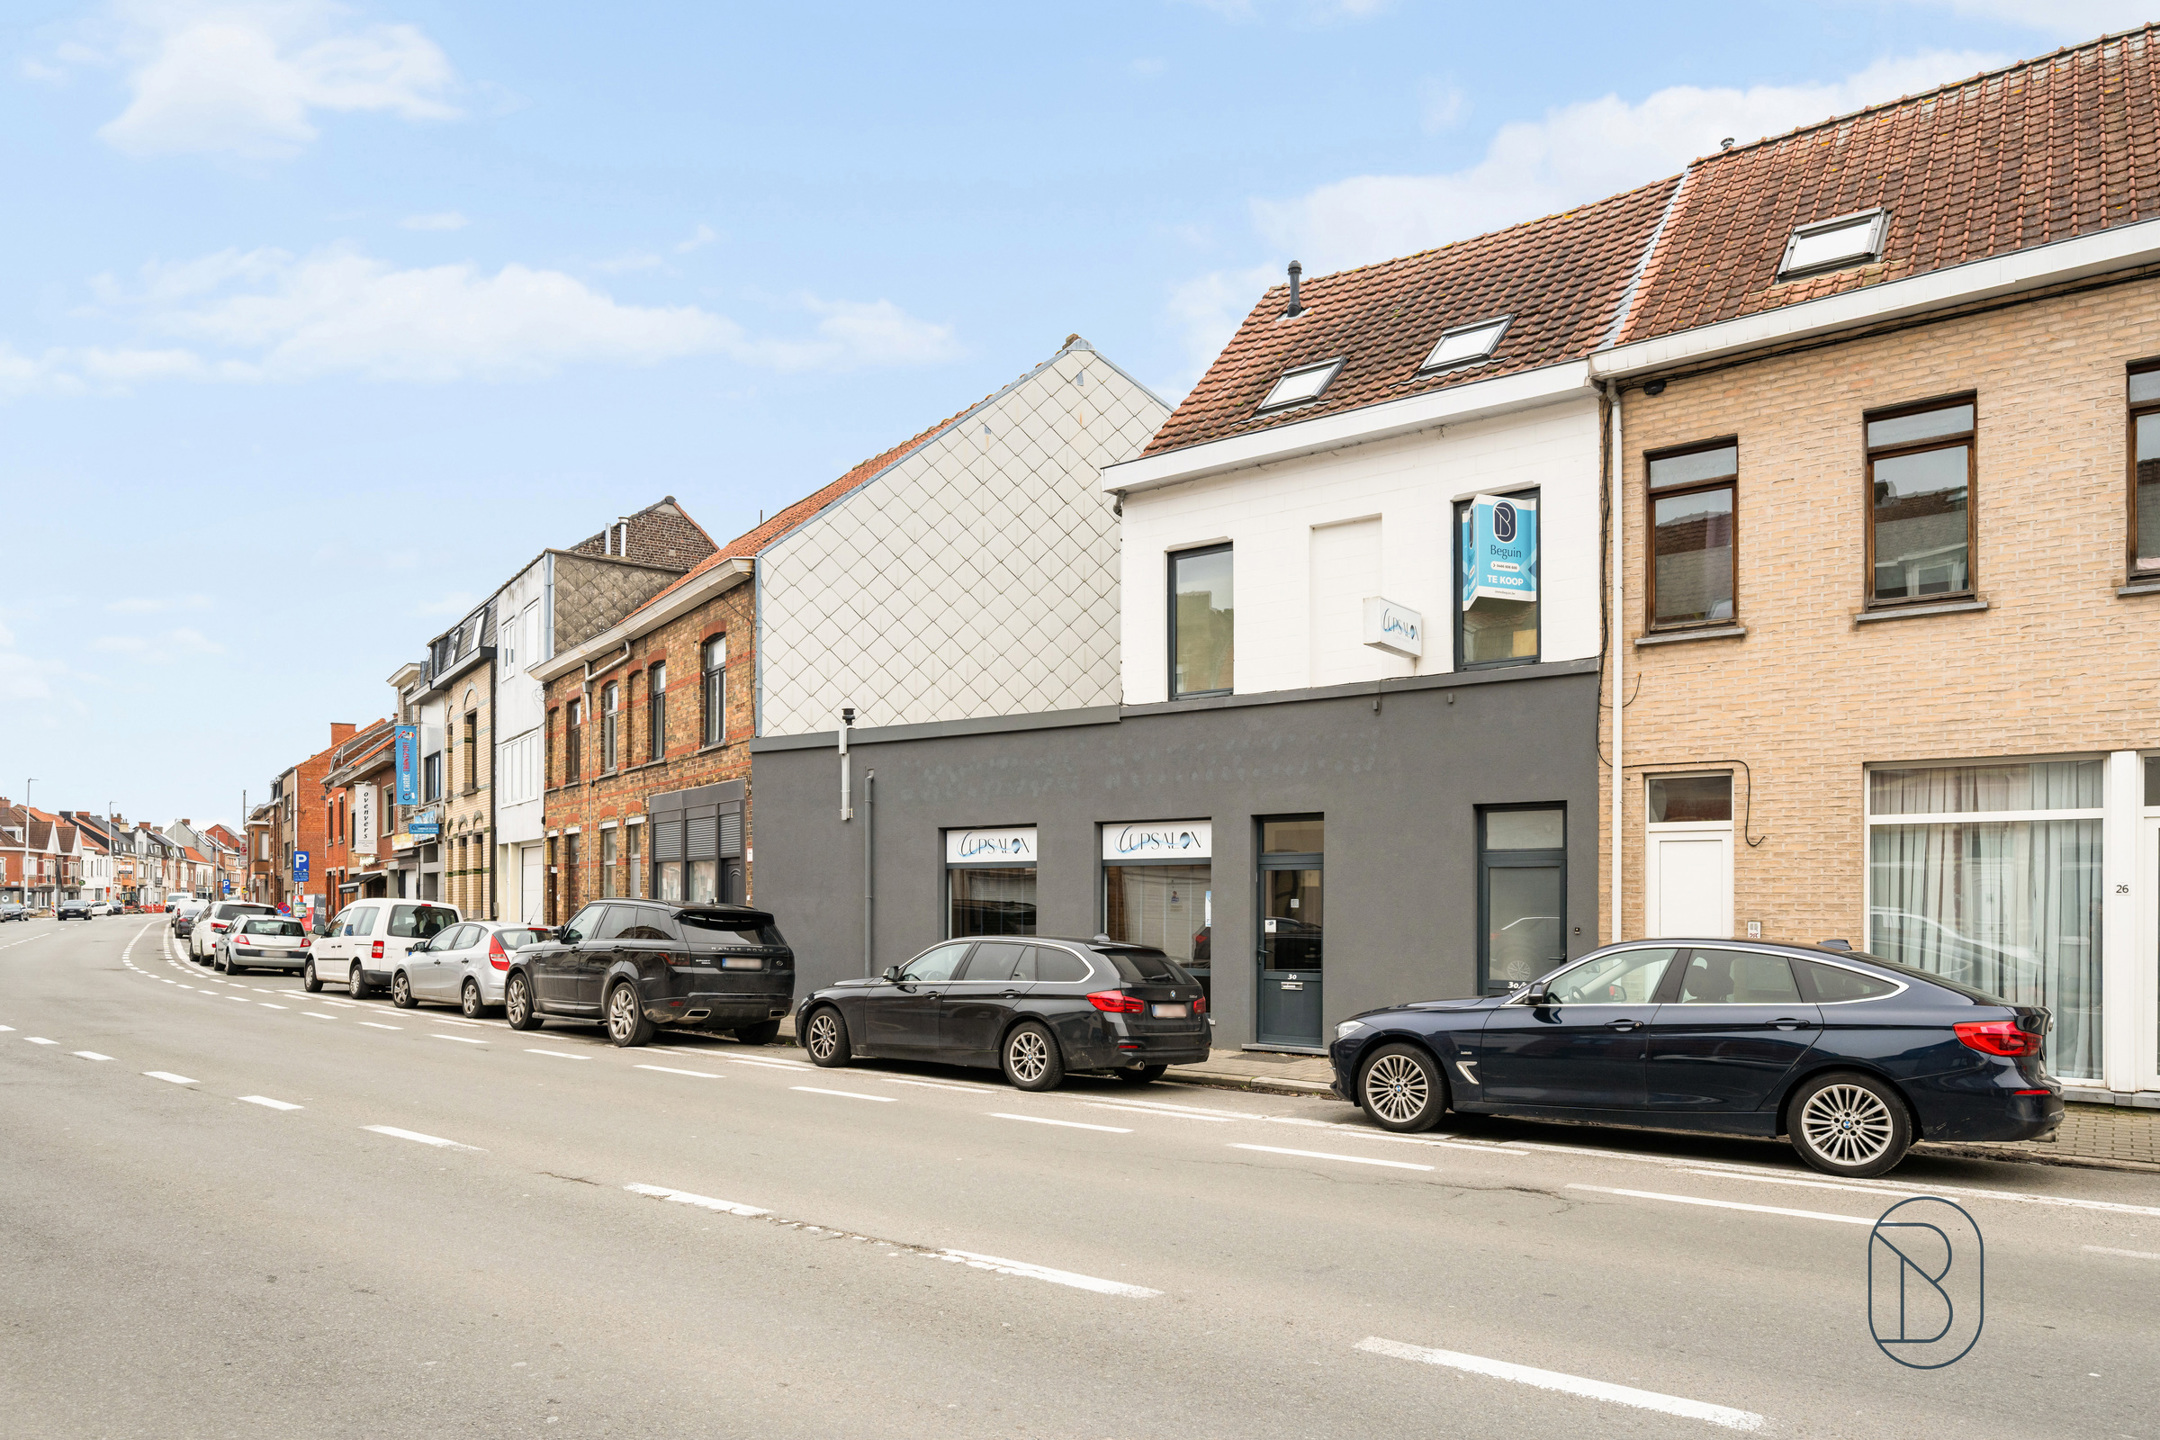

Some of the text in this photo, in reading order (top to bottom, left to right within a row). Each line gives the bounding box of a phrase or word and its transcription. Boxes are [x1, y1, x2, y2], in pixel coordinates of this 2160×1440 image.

[1490, 544, 1522, 560] Beguin
[1487, 574, 1524, 586] TE KOOP
[295, 854, 307, 868] P
[2115, 884, 2129, 894] 26
